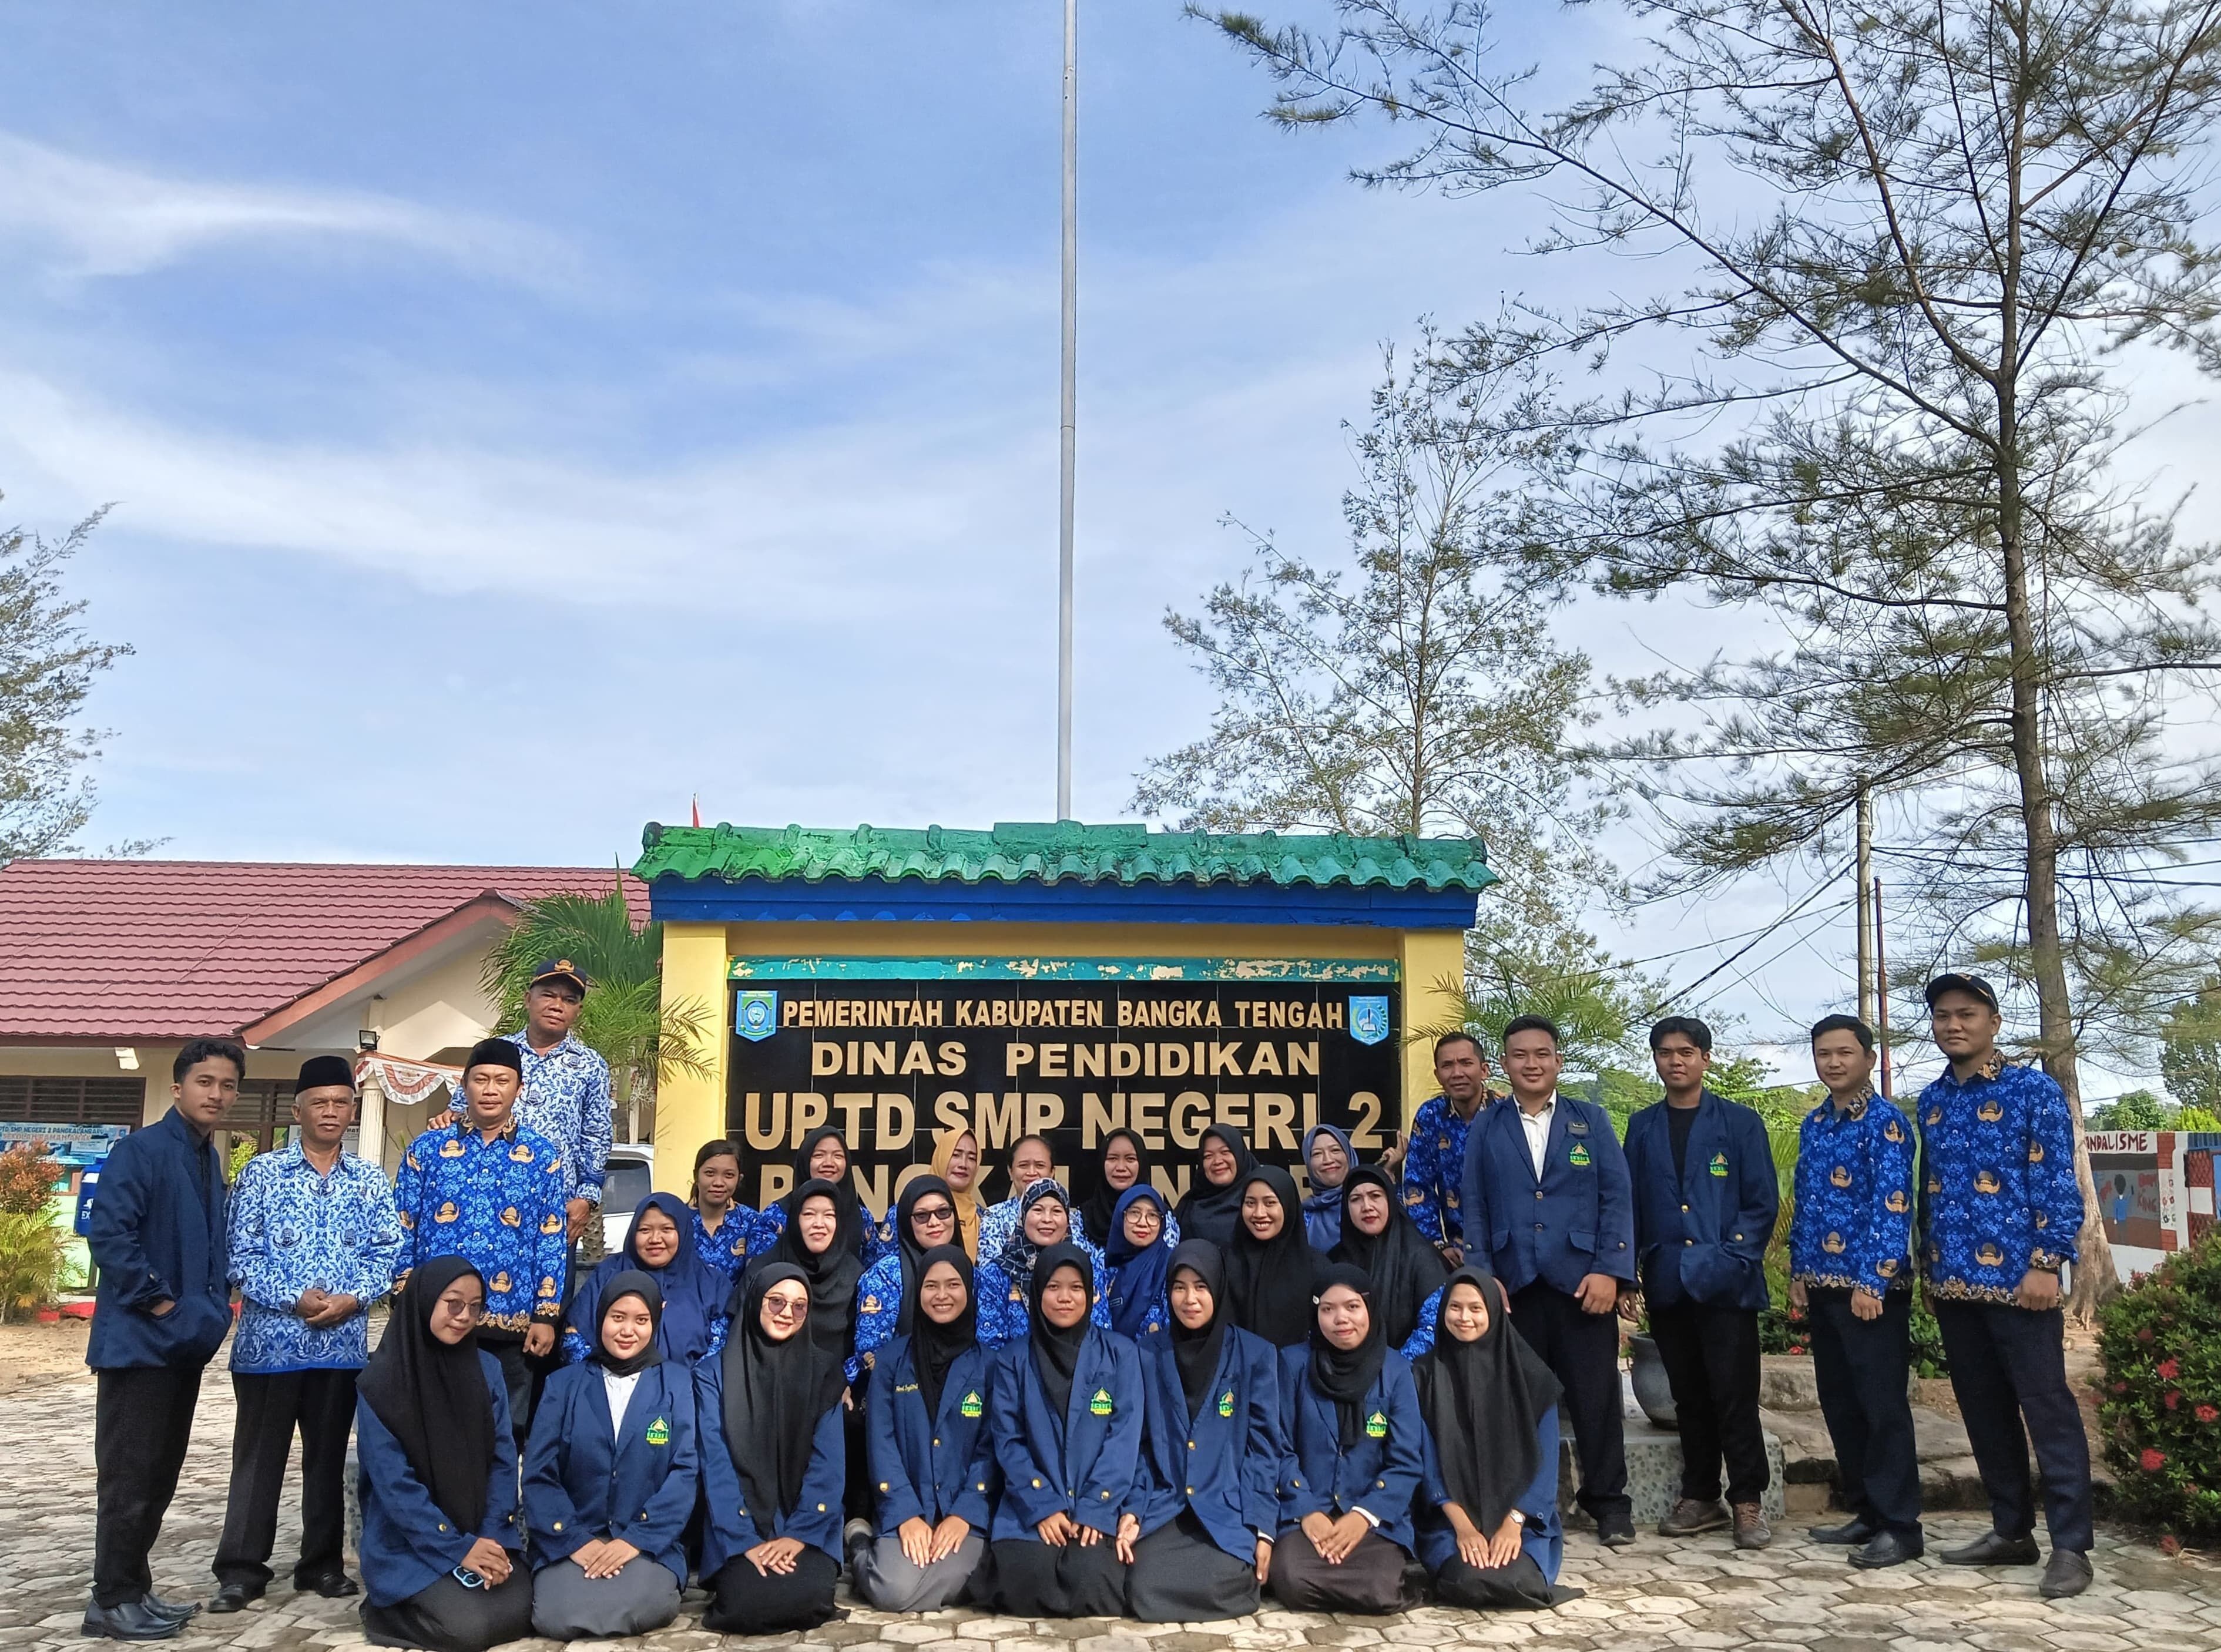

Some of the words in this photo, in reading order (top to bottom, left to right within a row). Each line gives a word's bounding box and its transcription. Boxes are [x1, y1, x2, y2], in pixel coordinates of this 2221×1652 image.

[783, 1000, 942, 1027] PEMERINTAH
[955, 1000, 1103, 1027] KABUPATEN
[1118, 1000, 1222, 1027] BANGKA
[1234, 1000, 1343, 1028] TENGAH
[811, 1040, 967, 1076] DINAS
[1005, 1041, 1320, 1077] PENDIDIKAN
[744, 1092, 915, 1151] UPTD
[931, 1091, 1065, 1150] SMP
[1082, 1091, 1317, 1150] NEGERI
[1348, 1091, 1383, 1149] 2
[2086, 1132, 2148, 1152] ANDALISME
[81, 1210, 90, 1220] EX
